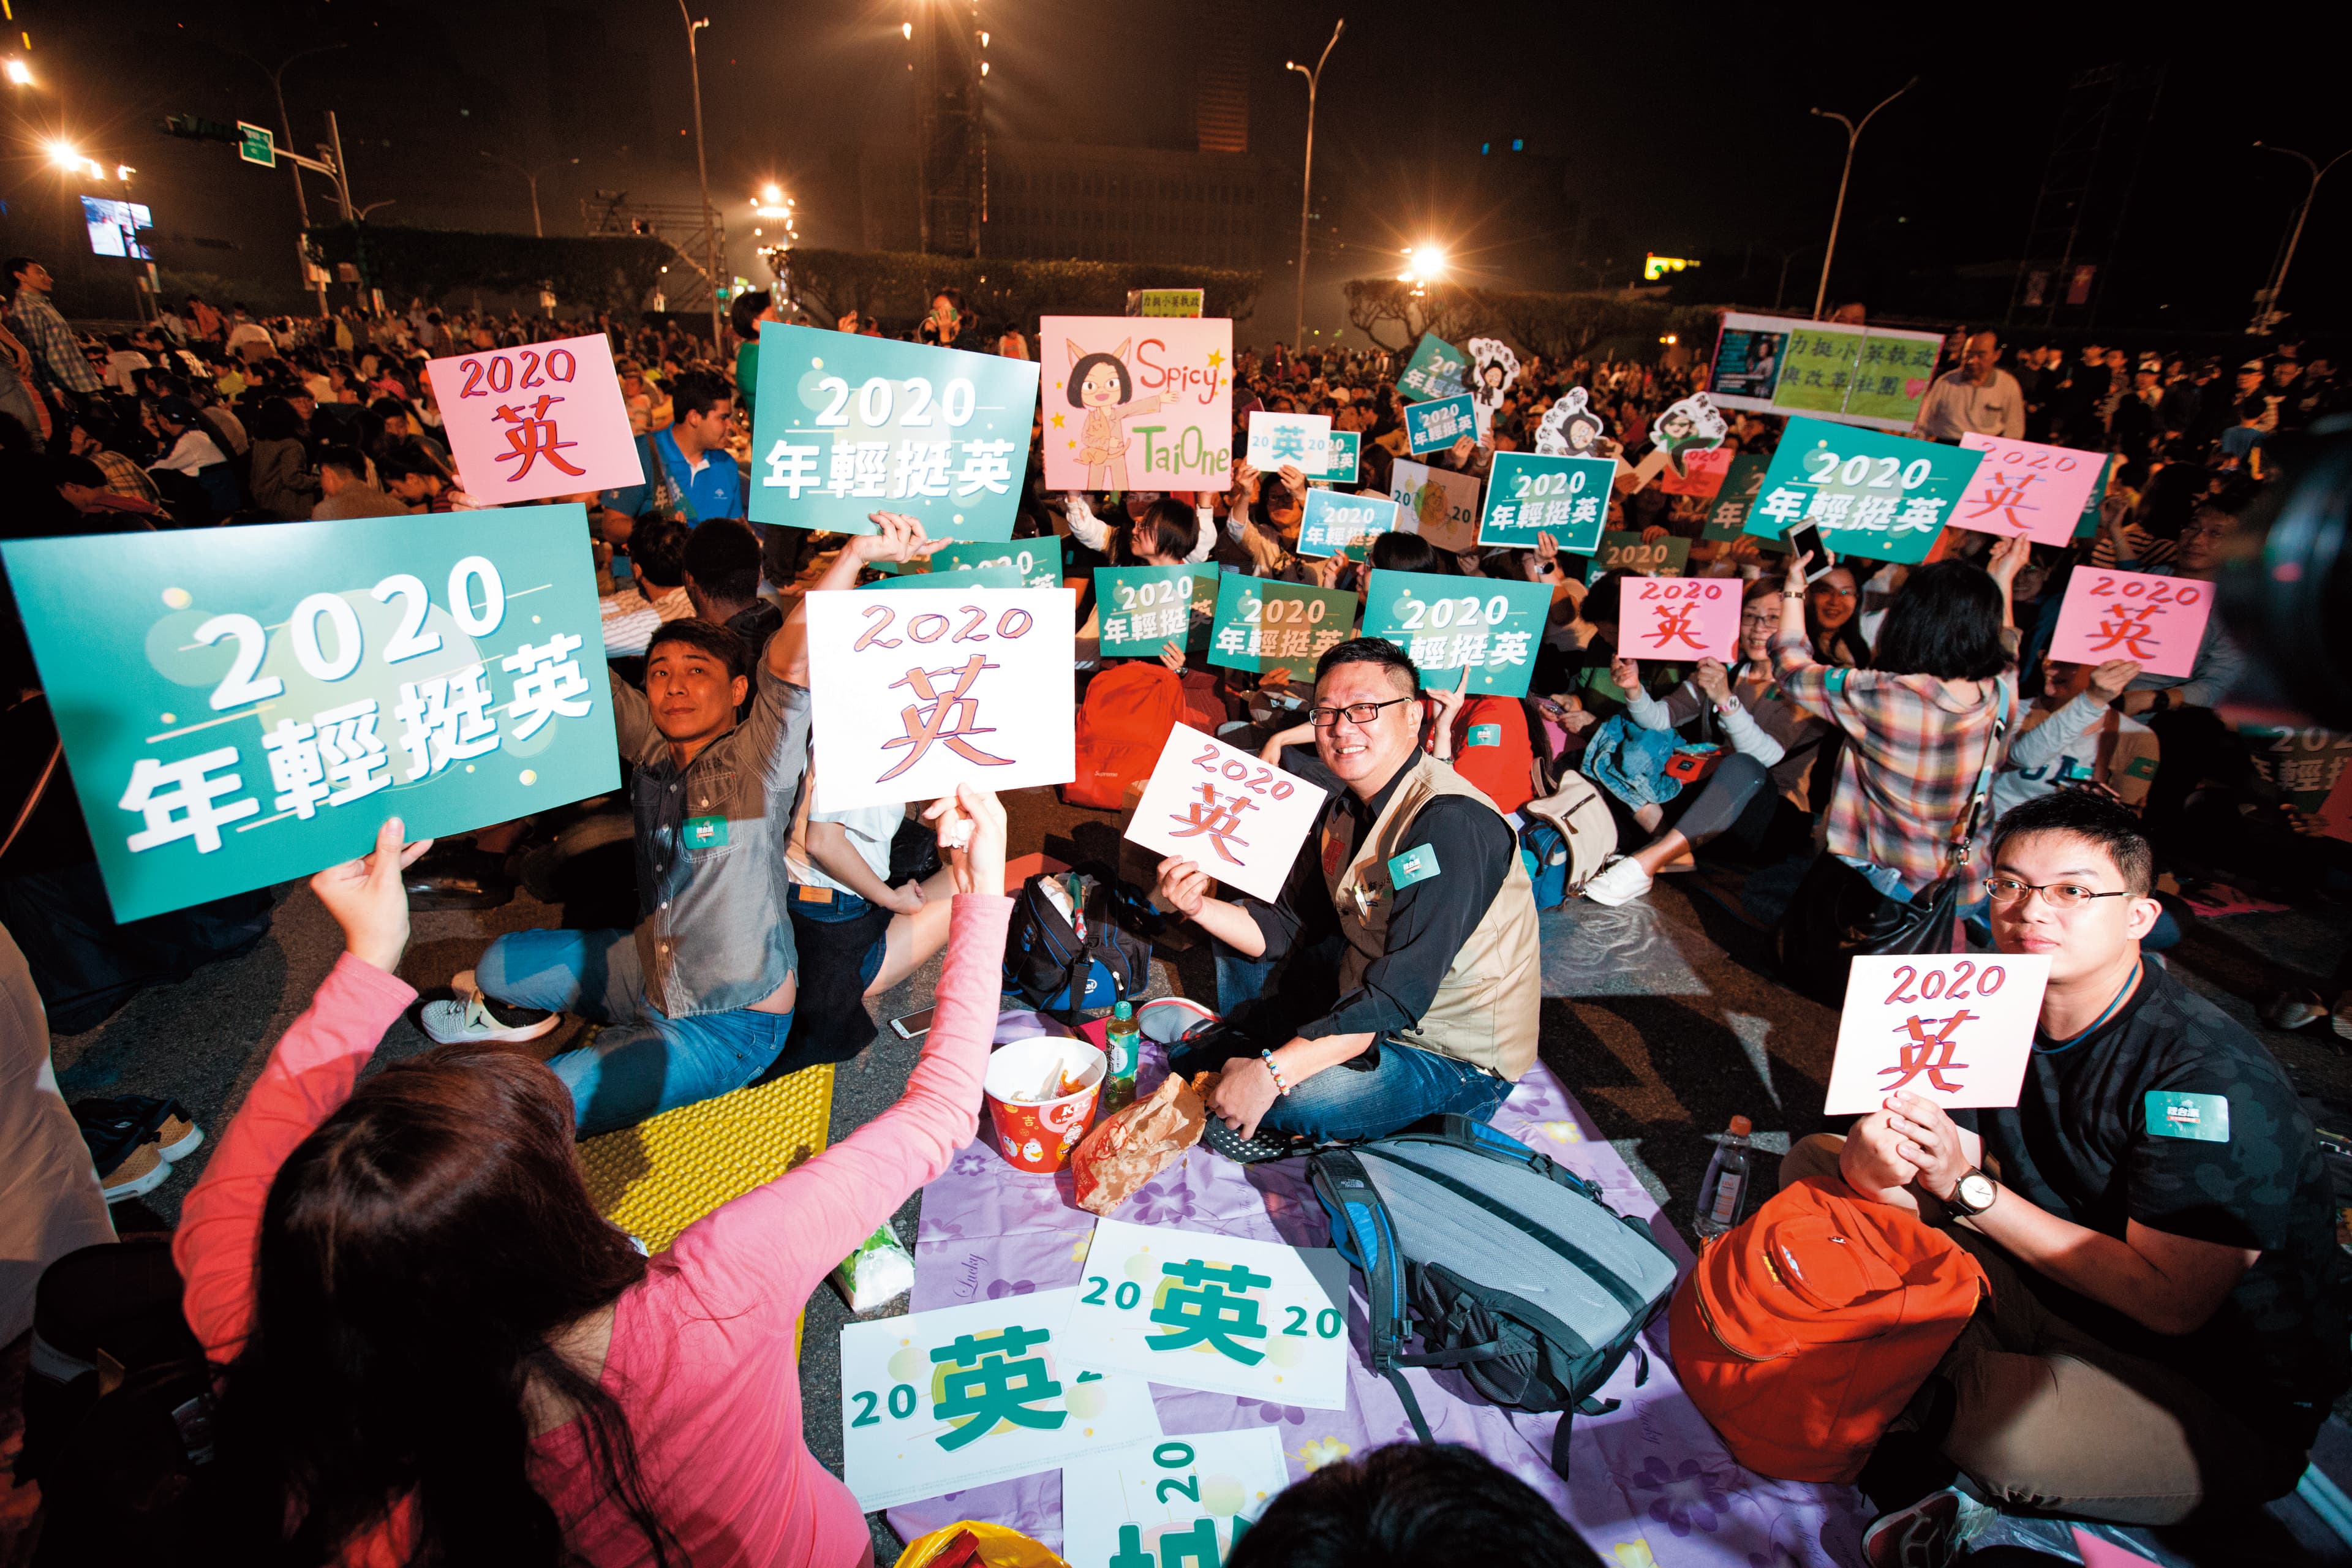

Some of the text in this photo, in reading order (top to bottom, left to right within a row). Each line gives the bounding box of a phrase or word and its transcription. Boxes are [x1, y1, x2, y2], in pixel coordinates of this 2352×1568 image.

[460, 349, 576, 399] 2020
[1136, 338, 1219, 405] Spicy
[815, 377, 977, 427] 2020
[1422, 403, 1460, 428] 2020
[491, 394, 586, 482] 英
[1131, 425, 1230, 476] TaiOne
[1252, 425, 1325, 461] 20 英 20
[1328, 438, 1345, 451] 20
[1414, 414, 1472, 446] 年輕挺英
[763, 439, 1016, 499] 年輕挺英
[1807, 452, 1932, 490] 2020
[1981, 440, 2078, 472] 2020
[1394, 489, 1471, 523] 20 20
[1515, 470, 1586, 499] 2020
[1963, 471, 2047, 530] 英
[1324, 507, 1375, 524] 2020
[1488, 497, 1600, 531] 年輕挺英
[1758, 486, 1948, 534] 年輕挺英
[1607, 544, 1668, 565] 2020
[1121, 575, 1193, 611] 2020
[1243, 598, 1326, 624] 2020
[1401, 595, 1510, 630] 2020
[1639, 581, 1723, 601] 2020
[2089, 576, 2201, 605] 2020
[192, 555, 507, 711] 2020
[853, 604, 1033, 652] 2020
[1104, 598, 1214, 645] 年輕挺英
[1215, 627, 1344, 659] 年輕挺英
[1640, 601, 1710, 650] 英
[2085, 603, 2168, 660] 英
[1389, 631, 1532, 670] 輕挺英
[875, 654, 1017, 785] 英
[118, 633, 593, 854] 年輕挺英
[1192, 743, 1295, 801] 2020
[1169, 782, 1261, 867] 英
[1883, 960, 2006, 1005] 2020
[1876, 1008, 1981, 1094] 英
[1061, 1096, 1091, 1117] KFC
[952, 1251, 990, 1299] Lucky
[1081, 1258, 1342, 1368] 20 英 20
[850, 1382, 918, 1430] 20
[929, 1325, 1069, 1453] 英
[1152, 1442, 1201, 1504] 20
